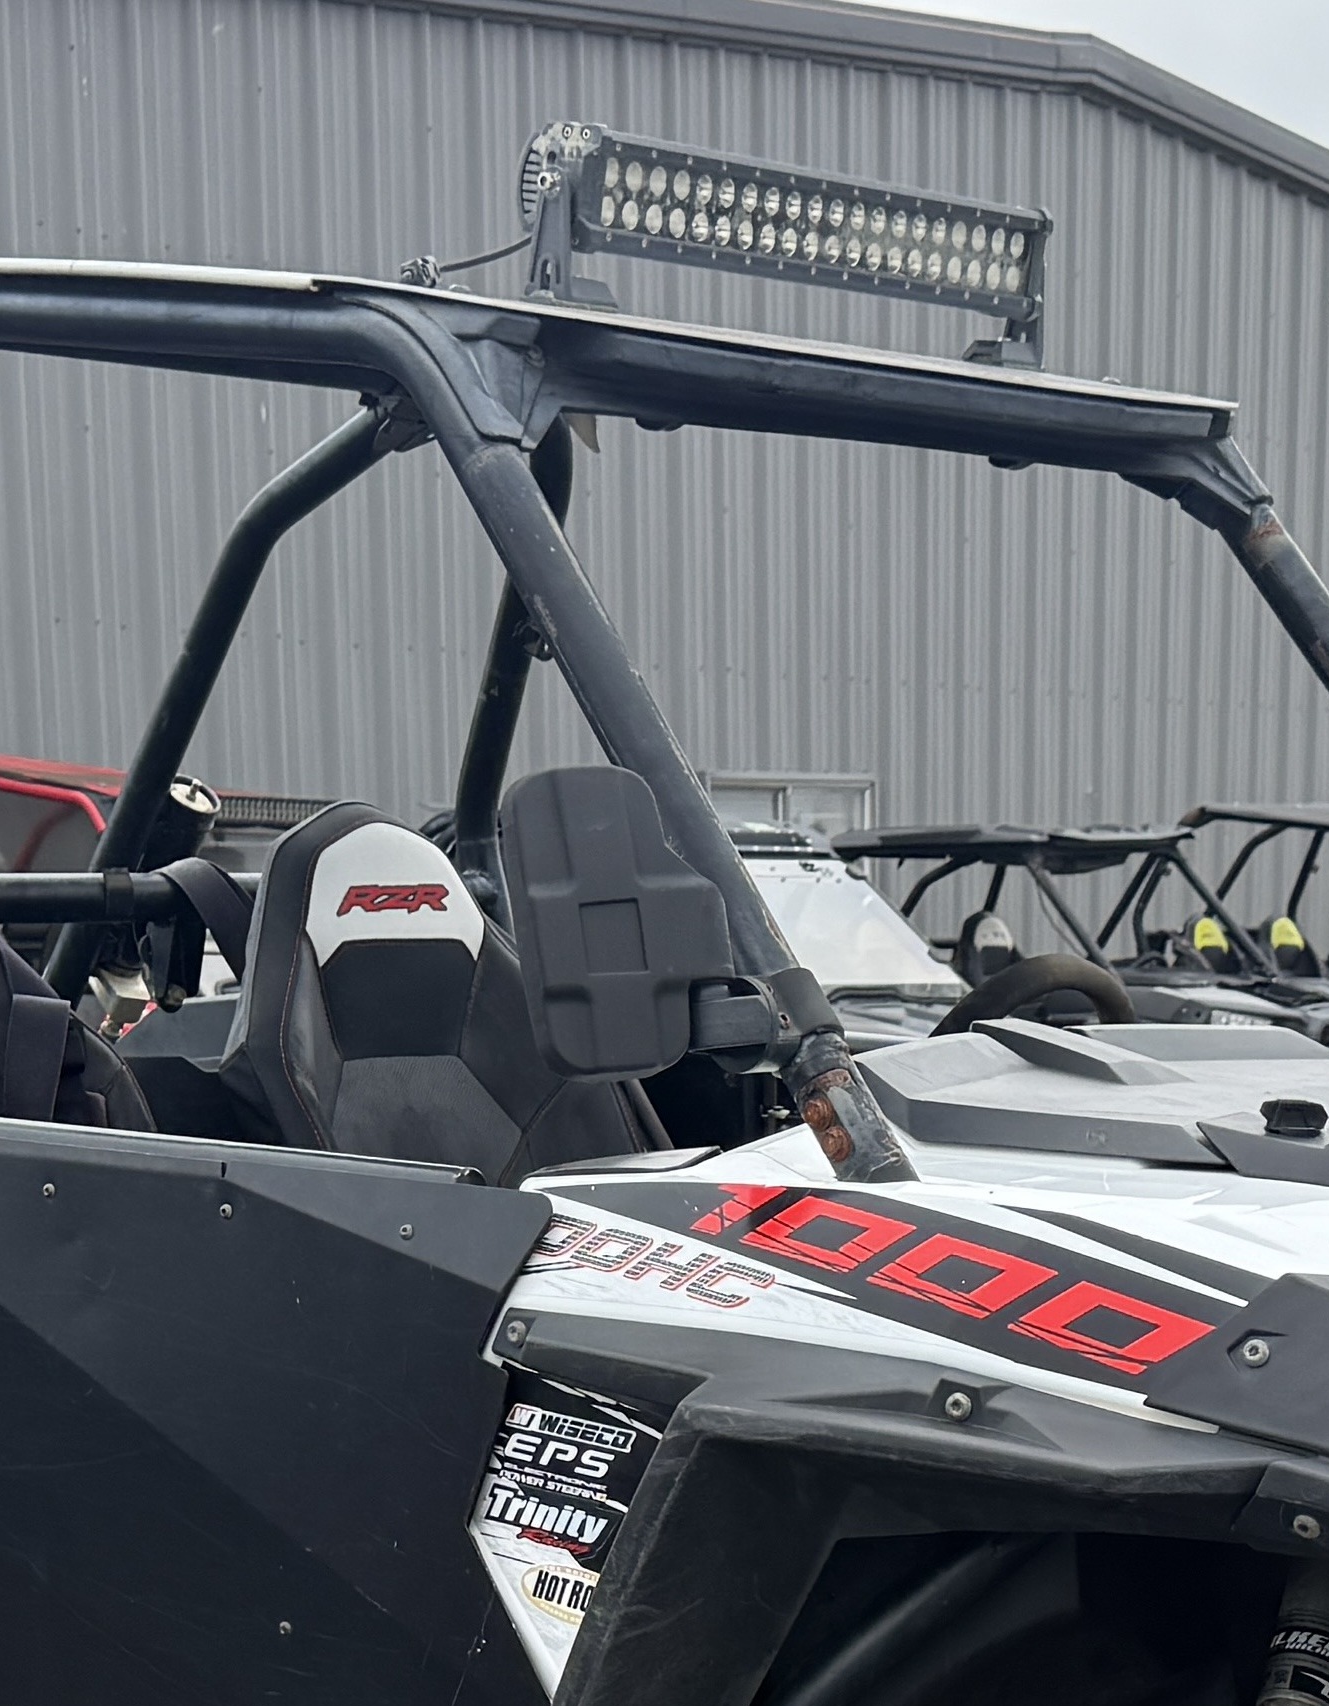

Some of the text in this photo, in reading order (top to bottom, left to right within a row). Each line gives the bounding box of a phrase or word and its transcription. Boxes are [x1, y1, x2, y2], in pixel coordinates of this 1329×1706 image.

[336, 884, 449, 917] RZR
[690, 1183, 1218, 1375] 1000
[504, 1433, 616, 1479] EPS
[499, 1469, 545, 1488] POWER
[487, 1487, 608, 1544] Trinity
[532, 1569, 571, 1605] HOT
